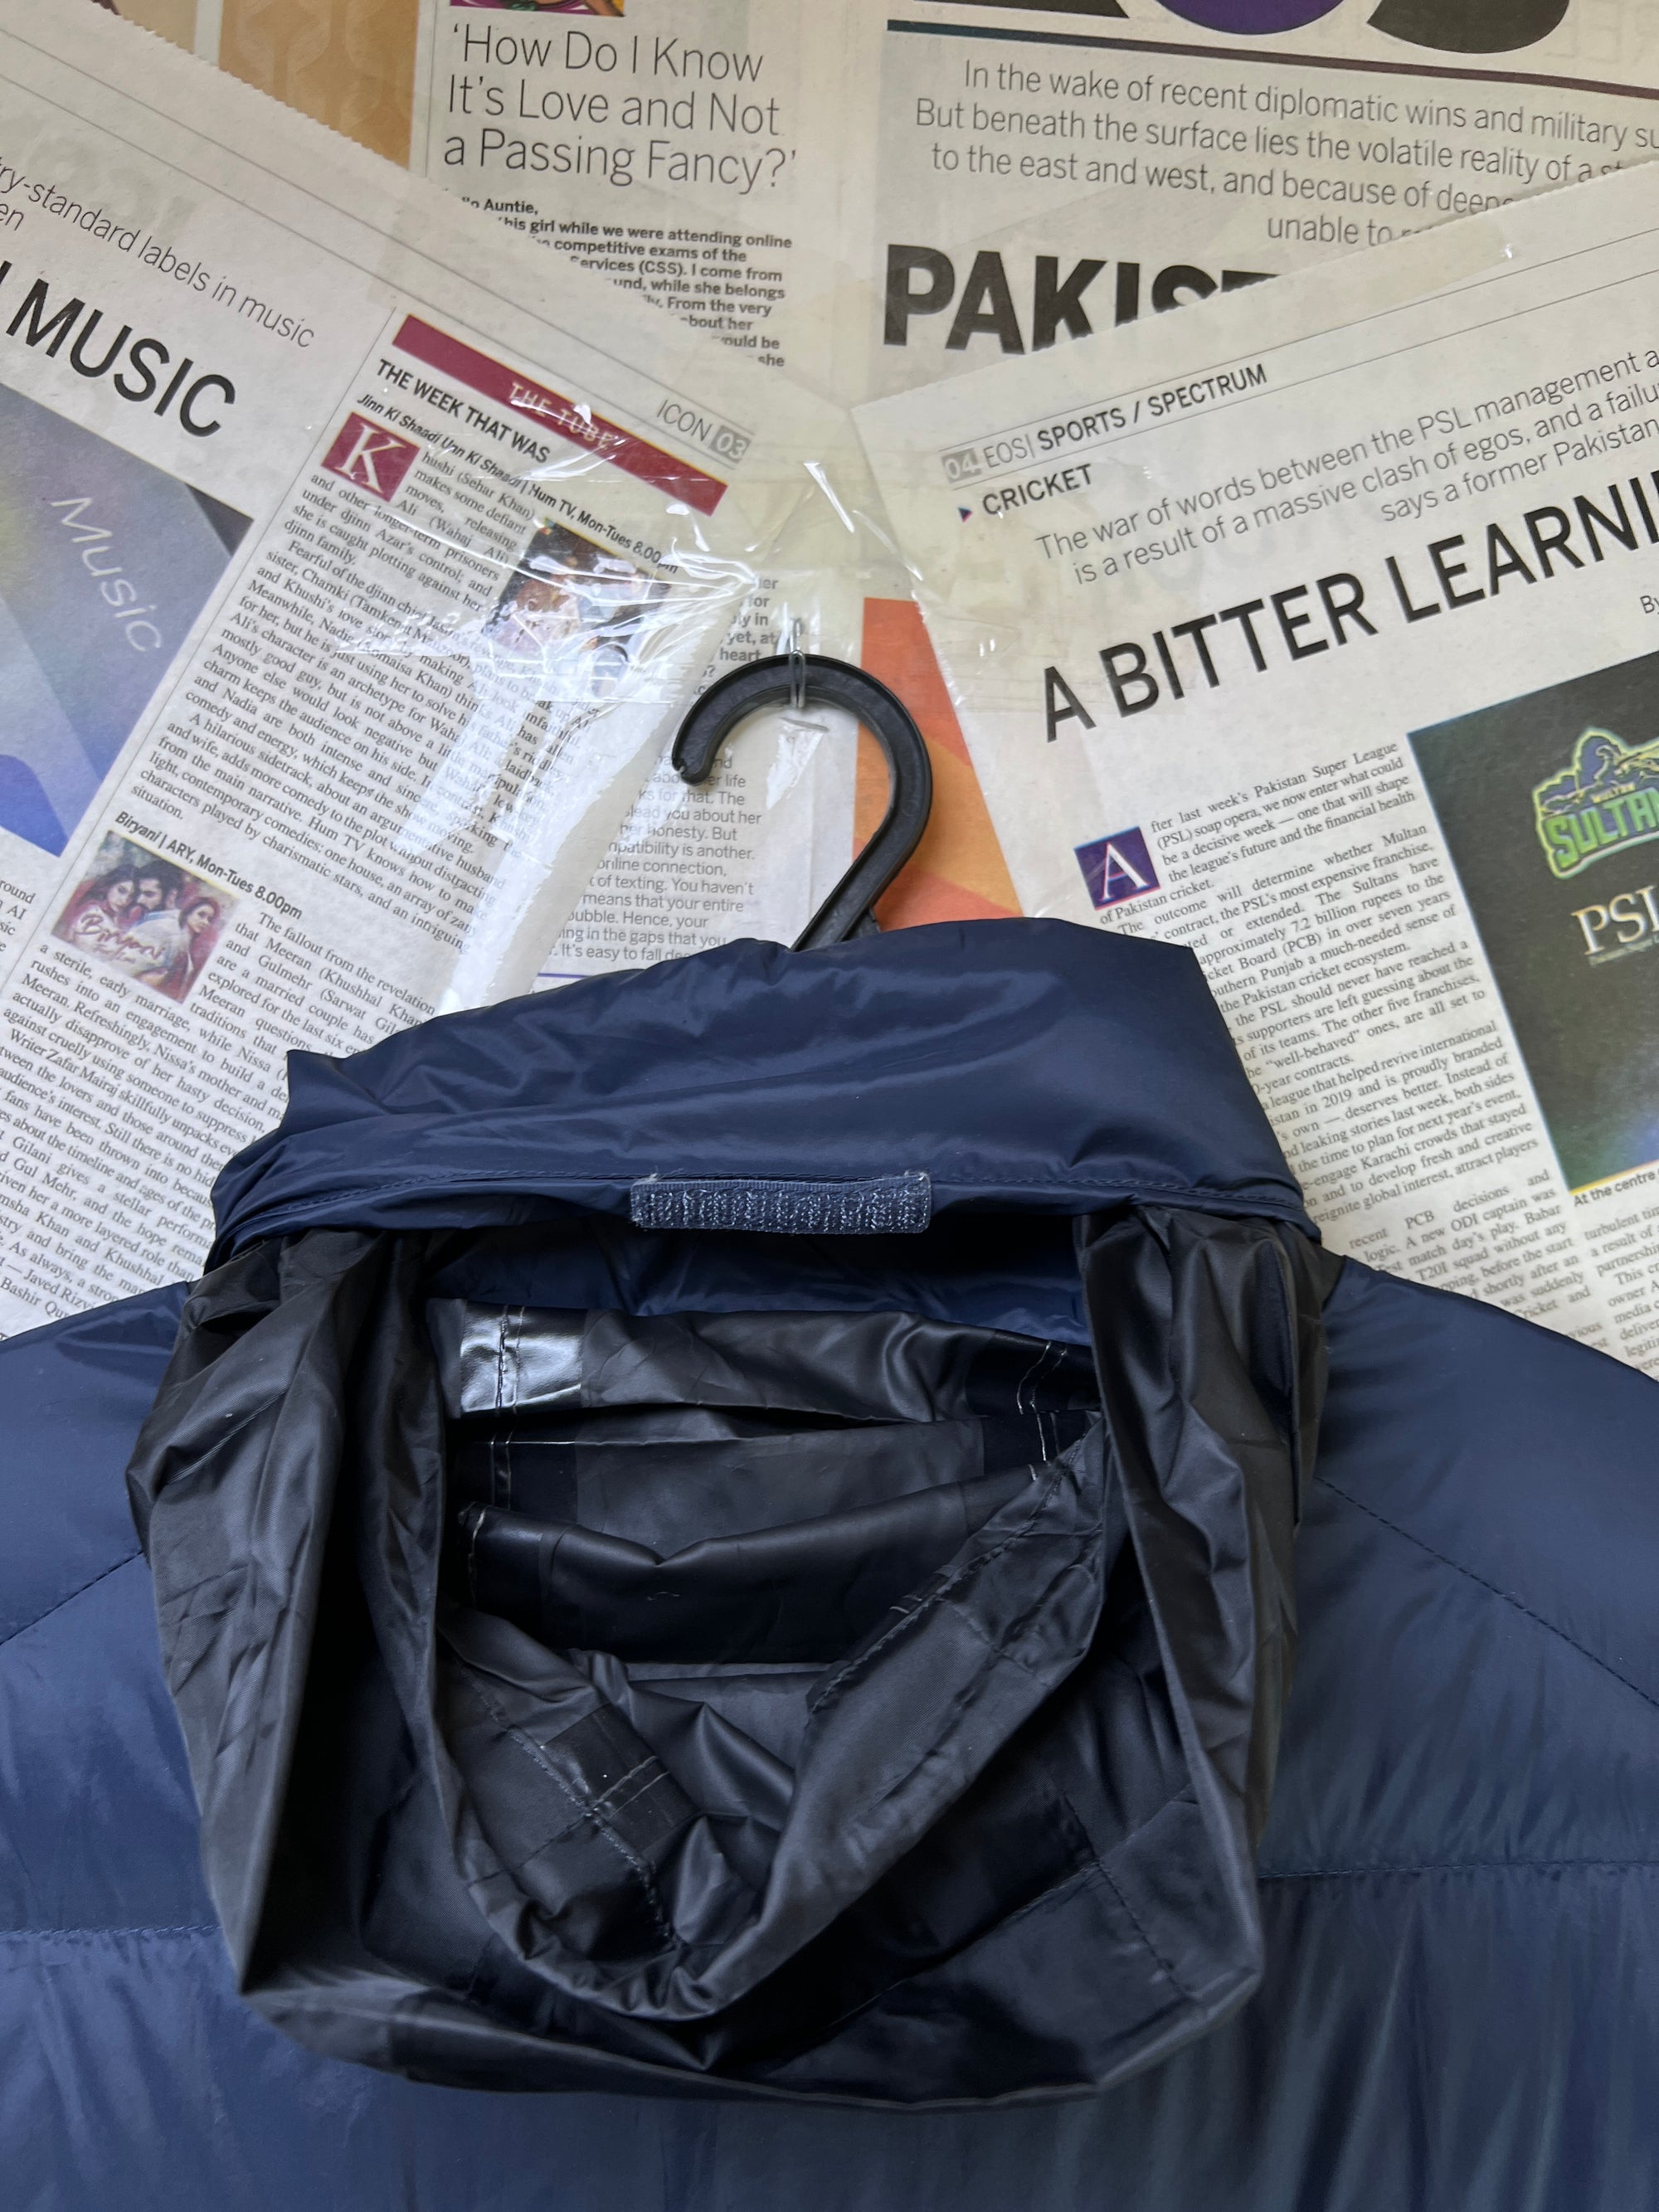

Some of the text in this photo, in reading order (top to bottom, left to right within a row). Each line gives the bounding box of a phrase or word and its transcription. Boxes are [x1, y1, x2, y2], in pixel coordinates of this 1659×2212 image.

[566, 31, 617, 71] Do
[633, 36, 637, 73] I
[654, 36, 763, 81] Know
[450, 75, 779, 135] It's Love and Not
[966, 60, 988, 88] In
[997, 63, 1040, 93] the
[1050, 70, 1118, 100] wake
[1127, 75, 1153, 101] of
[1161, 84, 1248, 110] recent
[1255, 85, 1398, 123] diplomatic
[1405, 100, 1467, 128] wins
[1474, 106, 1523, 133] and
[1531, 111, 1627, 151] military
[445, 136, 465, 166] a
[480, 128, 635, 186] Passing
[917, 98, 964, 129] But
[974, 103, 1085, 139] beneath
[1093, 113, 1138, 143] the
[1146, 120, 1247, 152] surface
[1256, 126, 1298, 156] lies
[1307, 131, 1350, 160] the
[1358, 137, 1453, 168] volatile
[1461, 147, 1540, 184] reality
[1546, 154, 1572, 181] of
[1578, 163, 1592, 182] a
[932, 143, 959, 170] to
[967, 145, 1011, 174] the
[1020, 153, 1078, 180] east
[1086, 158, 1136, 184] and
[1145, 164, 1214, 194] west,
[1224, 168, 1274, 196] and
[1282, 170, 1397, 206] because
[1404, 181, 1430, 207] of
[484, 199, 538, 216] Auntie,
[499, 216, 791, 248] his girl while we were attending online
[1267, 214, 1359, 244] unable
[1367, 219, 1394, 246] to
[554, 241, 645, 255] competitive
[649, 247, 698, 259] exams
[702, 248, 718, 260] of
[722, 249, 747, 262] the
[639, 260, 687, 277] (CSS).
[692, 264, 696, 275] I
[700, 267, 742, 279] come
[746, 267, 781, 282] from
[138, 236, 210, 291] labels
[212, 277, 236, 307] in
[239, 297, 314, 347] music
[650, 279, 690, 292] while
[695, 281, 722, 294] she
[725, 283, 785, 301] belongs
[667, 296, 705, 310] From
[710, 299, 735, 312] the
[738, 304, 771, 317] very
[883, 244, 1280, 355] PAKIS
[727, 317, 753, 330] her
[761, 336, 780, 349] be
[6, 279, 236, 436] MUSIC
[377, 358, 550, 463] THE WEEK THAT WAS
[509, 382, 552, 418] THE
[657, 400, 748, 459] ICON 03
[945, 453, 983, 480] 04
[1037, 408, 1126, 450] SPORTS
[1148, 363, 1267, 416] SPECTRUM
[357, 394, 384, 413] Jinn
[383, 406, 401, 421] Ki
[398, 415, 443, 444] Shaadi
[465, 451, 483, 464] Ki
[528, 484, 557, 508] Hum
[559, 499, 577, 519] TV,
[577, 511, 632, 548] Mon-Tues
[422, 452, 454, 476] hushi
[457, 471, 496, 498] (Sehar
[499, 494, 535, 521] Khan)
[1035, 532, 1088, 559] The
[1092, 513, 1138, 542] war
[1147, 498, 1170, 525] of
[1176, 477, 1256, 516] words
[1258, 443, 1368, 489] between
[1371, 430, 1415, 455] the
[1418, 408, 1472, 440] PSL
[1475, 352, 1642, 422] management
[1073, 382, 1659, 584] is a result of a massive clash of egos, and a failu
[1382, 491, 1438, 521] says
[1443, 484, 1460, 501] a
[1463, 453, 1548, 494] former
[982, 463, 1090, 514] CRICKET
[51, 497, 162, 652] Music
[1045, 666, 1097, 742] A
[1098, 572, 1379, 717] BITTER
[1178, 809, 1201, 823] last
[1208, 793, 1248, 813] week's
[1254, 775, 1307, 798] Pakistan
[1312, 760, 1346, 778] Super
[1352, 744, 1397, 765] League
[114, 811, 163, 842] Biryani
[166, 839, 196, 863] ARY,
[196, 854, 254, 892] Mon-Tues
[255, 886, 302, 919] 8.00pm
[582, 892, 743, 912] means that your entire
[259, 912, 435, 1014] The fallout from the revelation
[1574, 1171, 1656, 1207] At the centre
